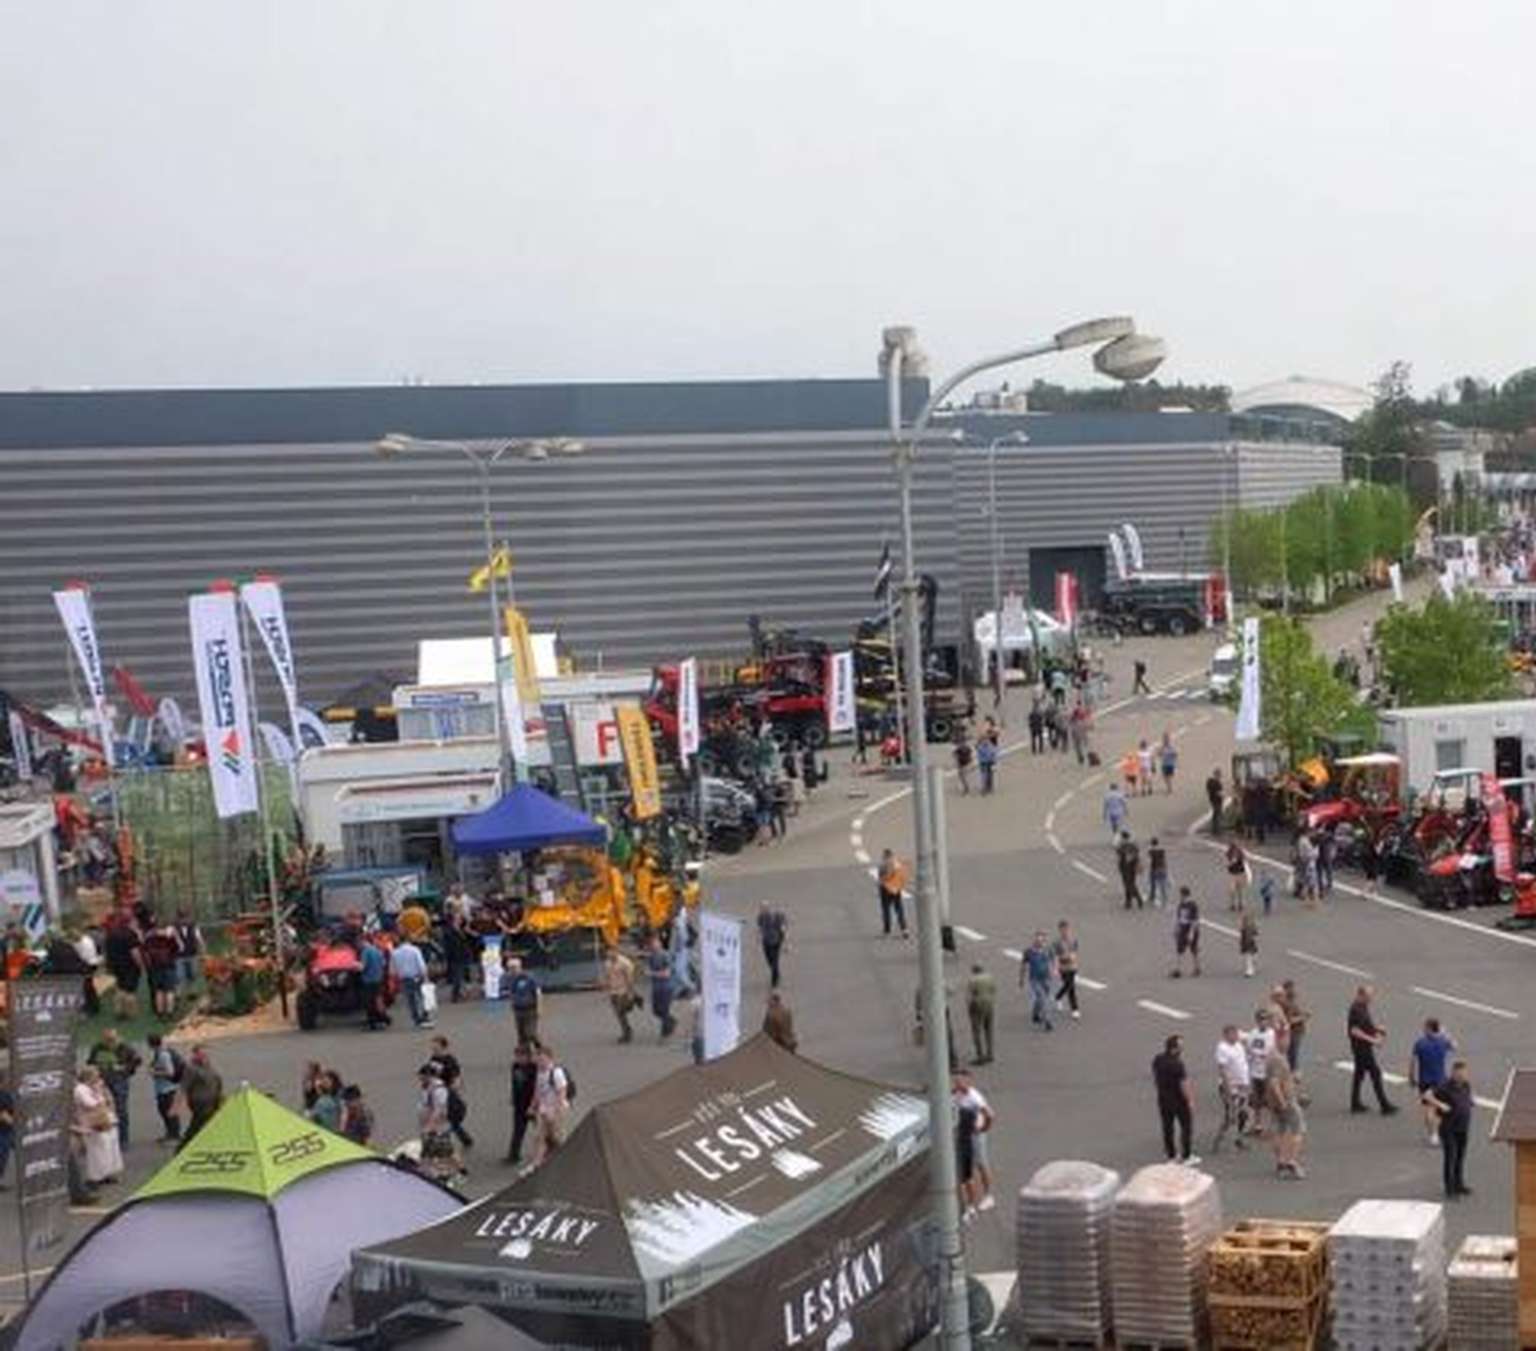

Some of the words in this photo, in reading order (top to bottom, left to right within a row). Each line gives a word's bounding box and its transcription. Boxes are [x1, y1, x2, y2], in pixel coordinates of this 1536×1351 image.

[676, 1095, 817, 1181] LESÁKY
[475, 1208, 599, 1246] LESÁKY
[784, 1241, 884, 1346] LESÁKY
